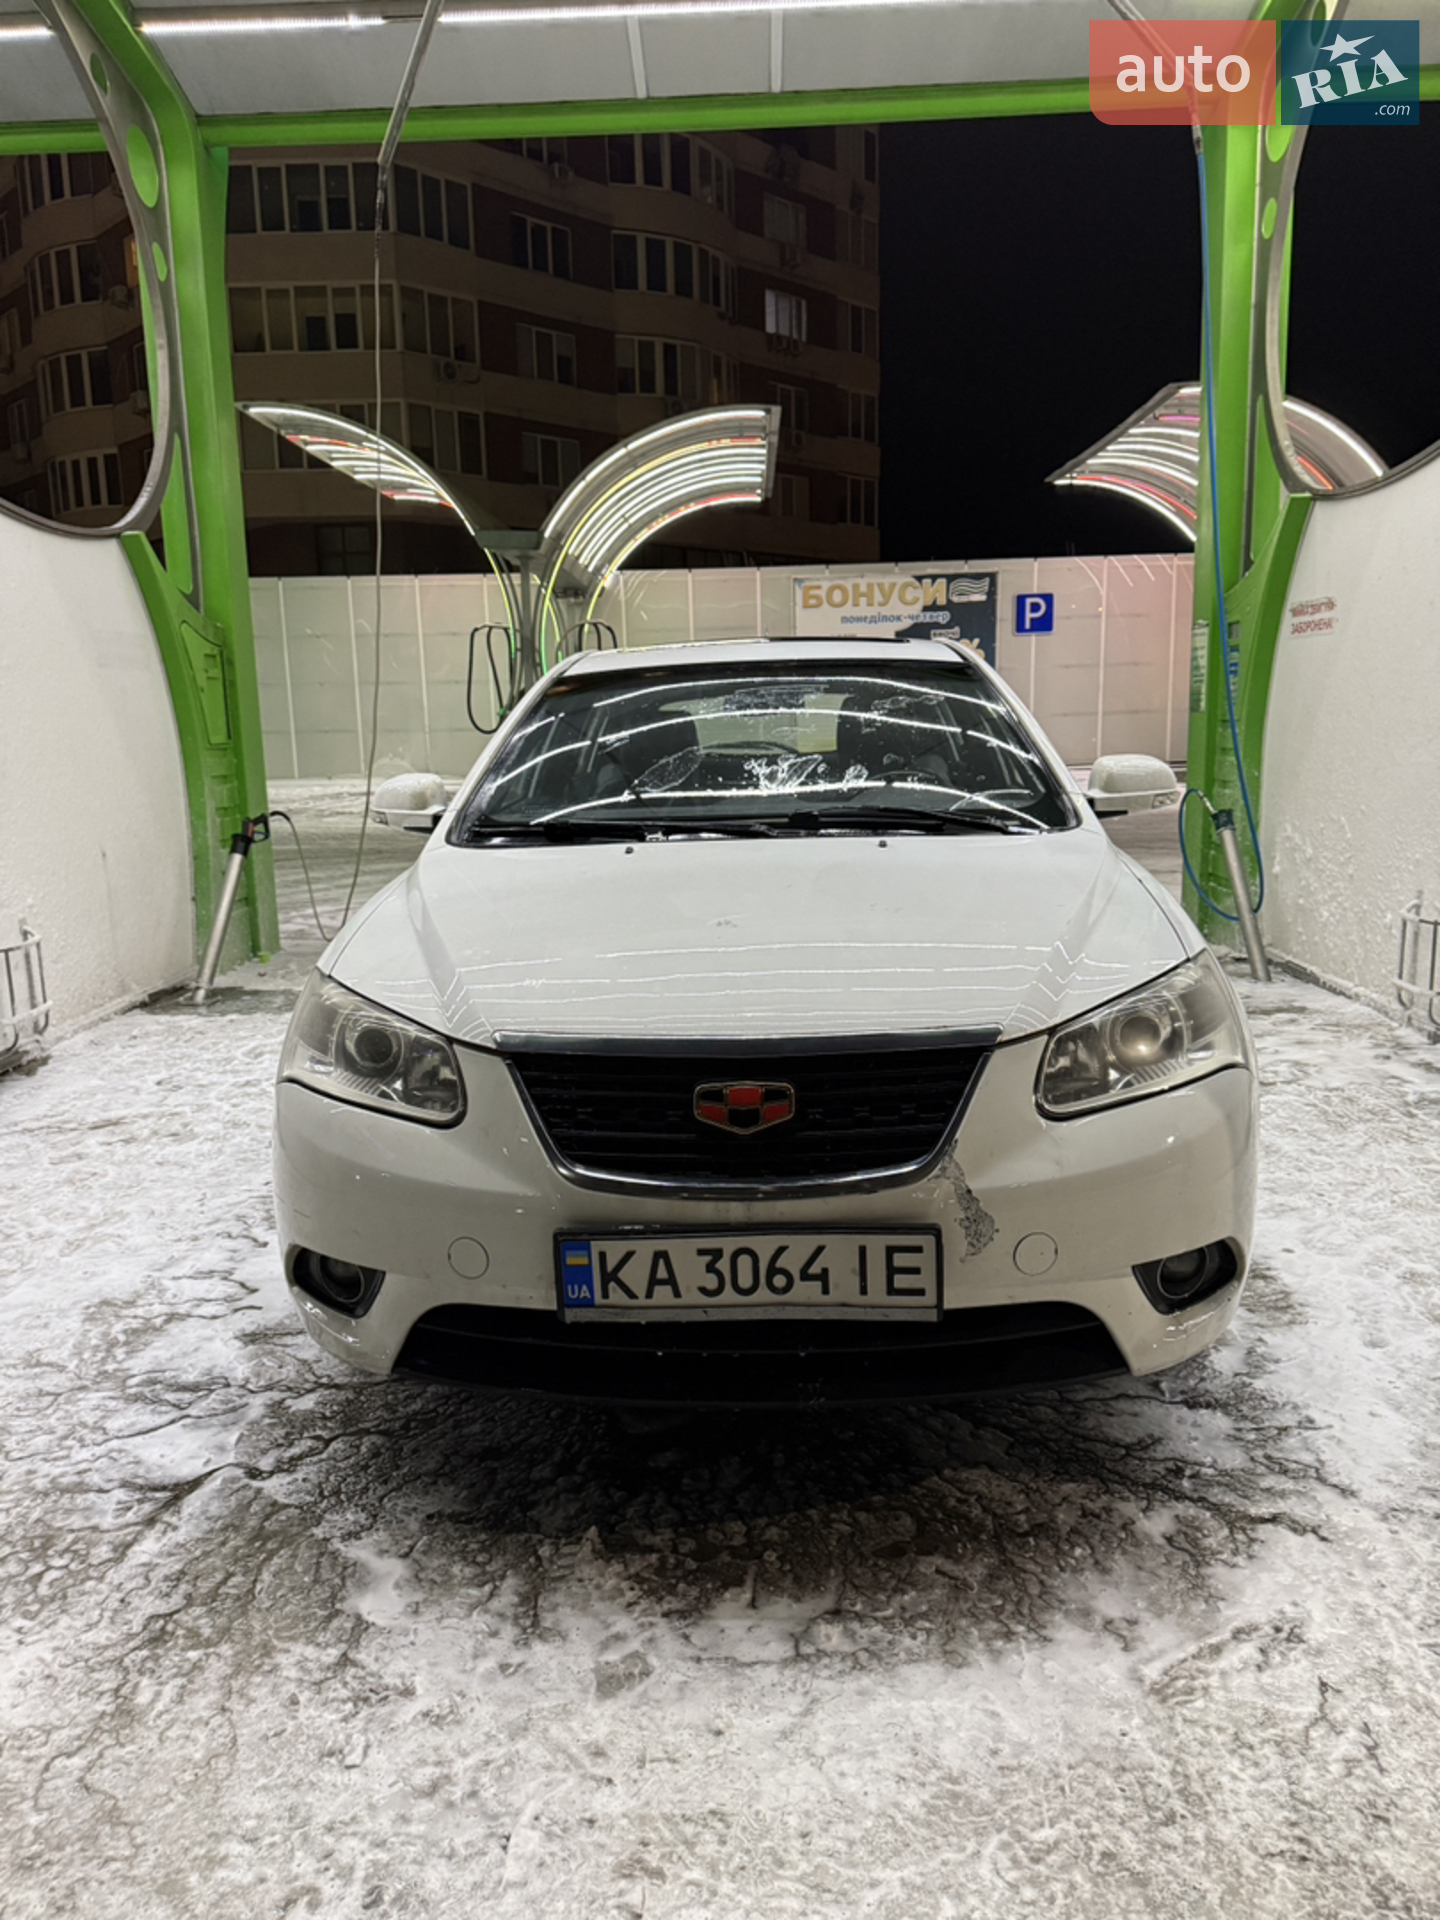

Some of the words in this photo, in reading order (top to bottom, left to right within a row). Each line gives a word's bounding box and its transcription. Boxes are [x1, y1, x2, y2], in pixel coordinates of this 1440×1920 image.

[802, 577, 947, 609] БОНУСИ
[1024, 597, 1046, 630] P
[598, 1250, 682, 1299] KA
[696, 1245, 830, 1297] 3064
[859, 1244, 926, 1297] IE
[567, 1283, 591, 1299] UA
